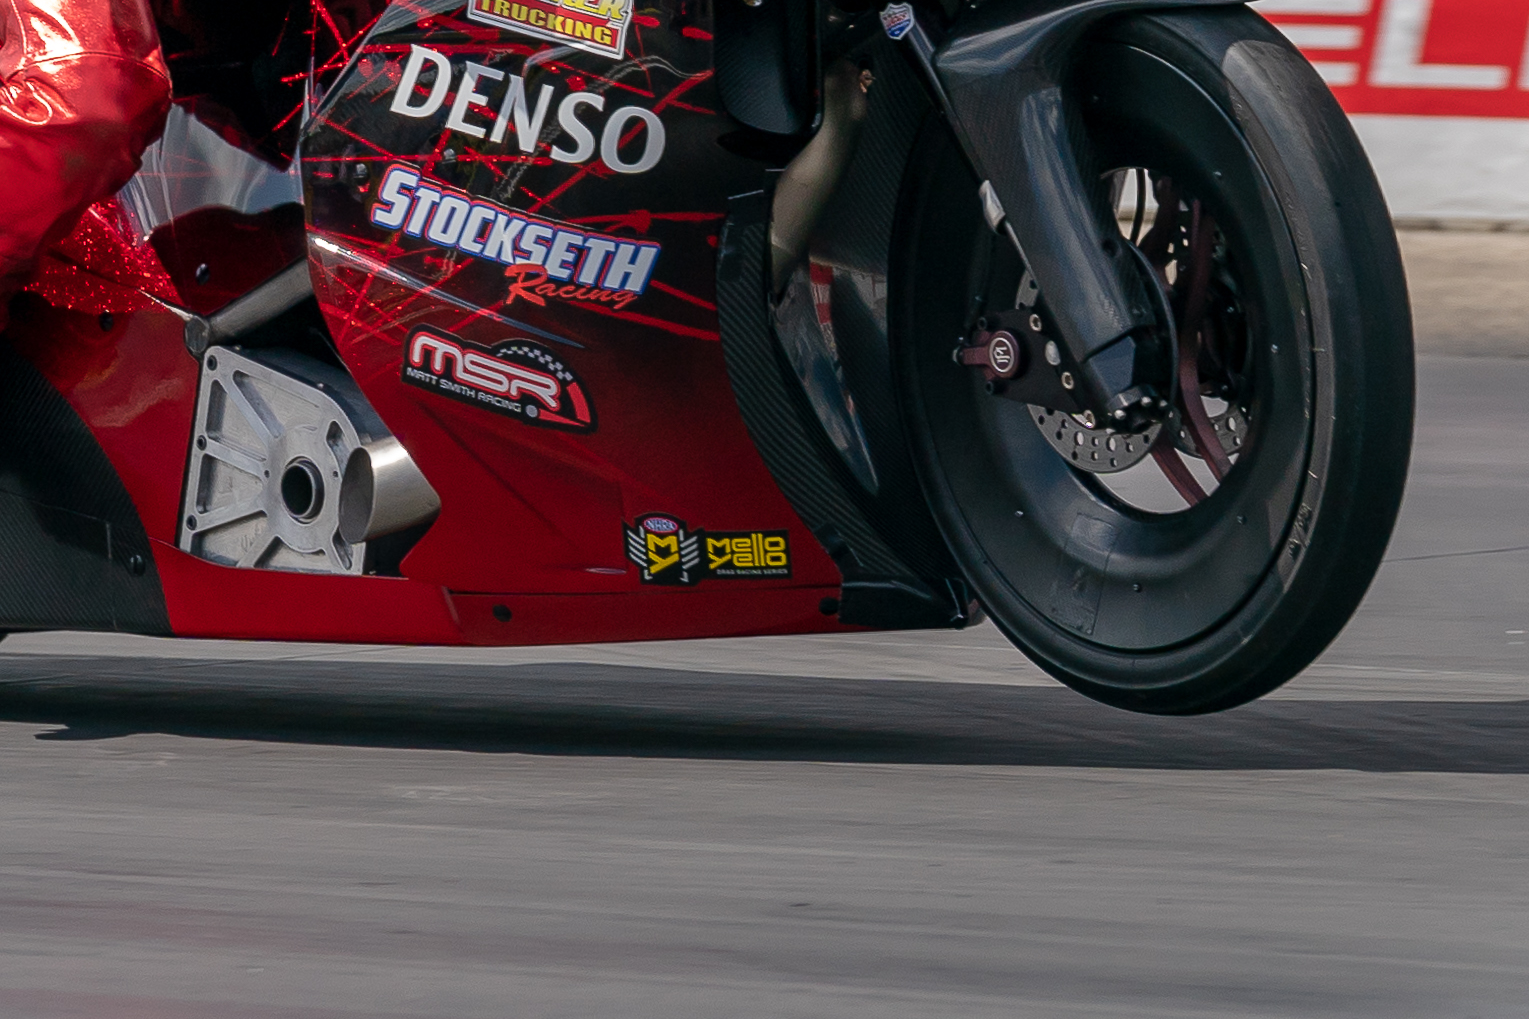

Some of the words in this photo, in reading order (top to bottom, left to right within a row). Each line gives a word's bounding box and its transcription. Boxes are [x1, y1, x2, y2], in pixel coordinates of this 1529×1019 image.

[390, 43, 666, 173] DENSO
[372, 163, 661, 295] STOCKSETH
[504, 262, 638, 309] Racing
[406, 367, 438, 385] MATT
[439, 378, 475, 398] SMITH
[477, 392, 522, 413] RACING
[410, 331, 560, 411] MSR
[644, 517, 677, 532] NHRA
